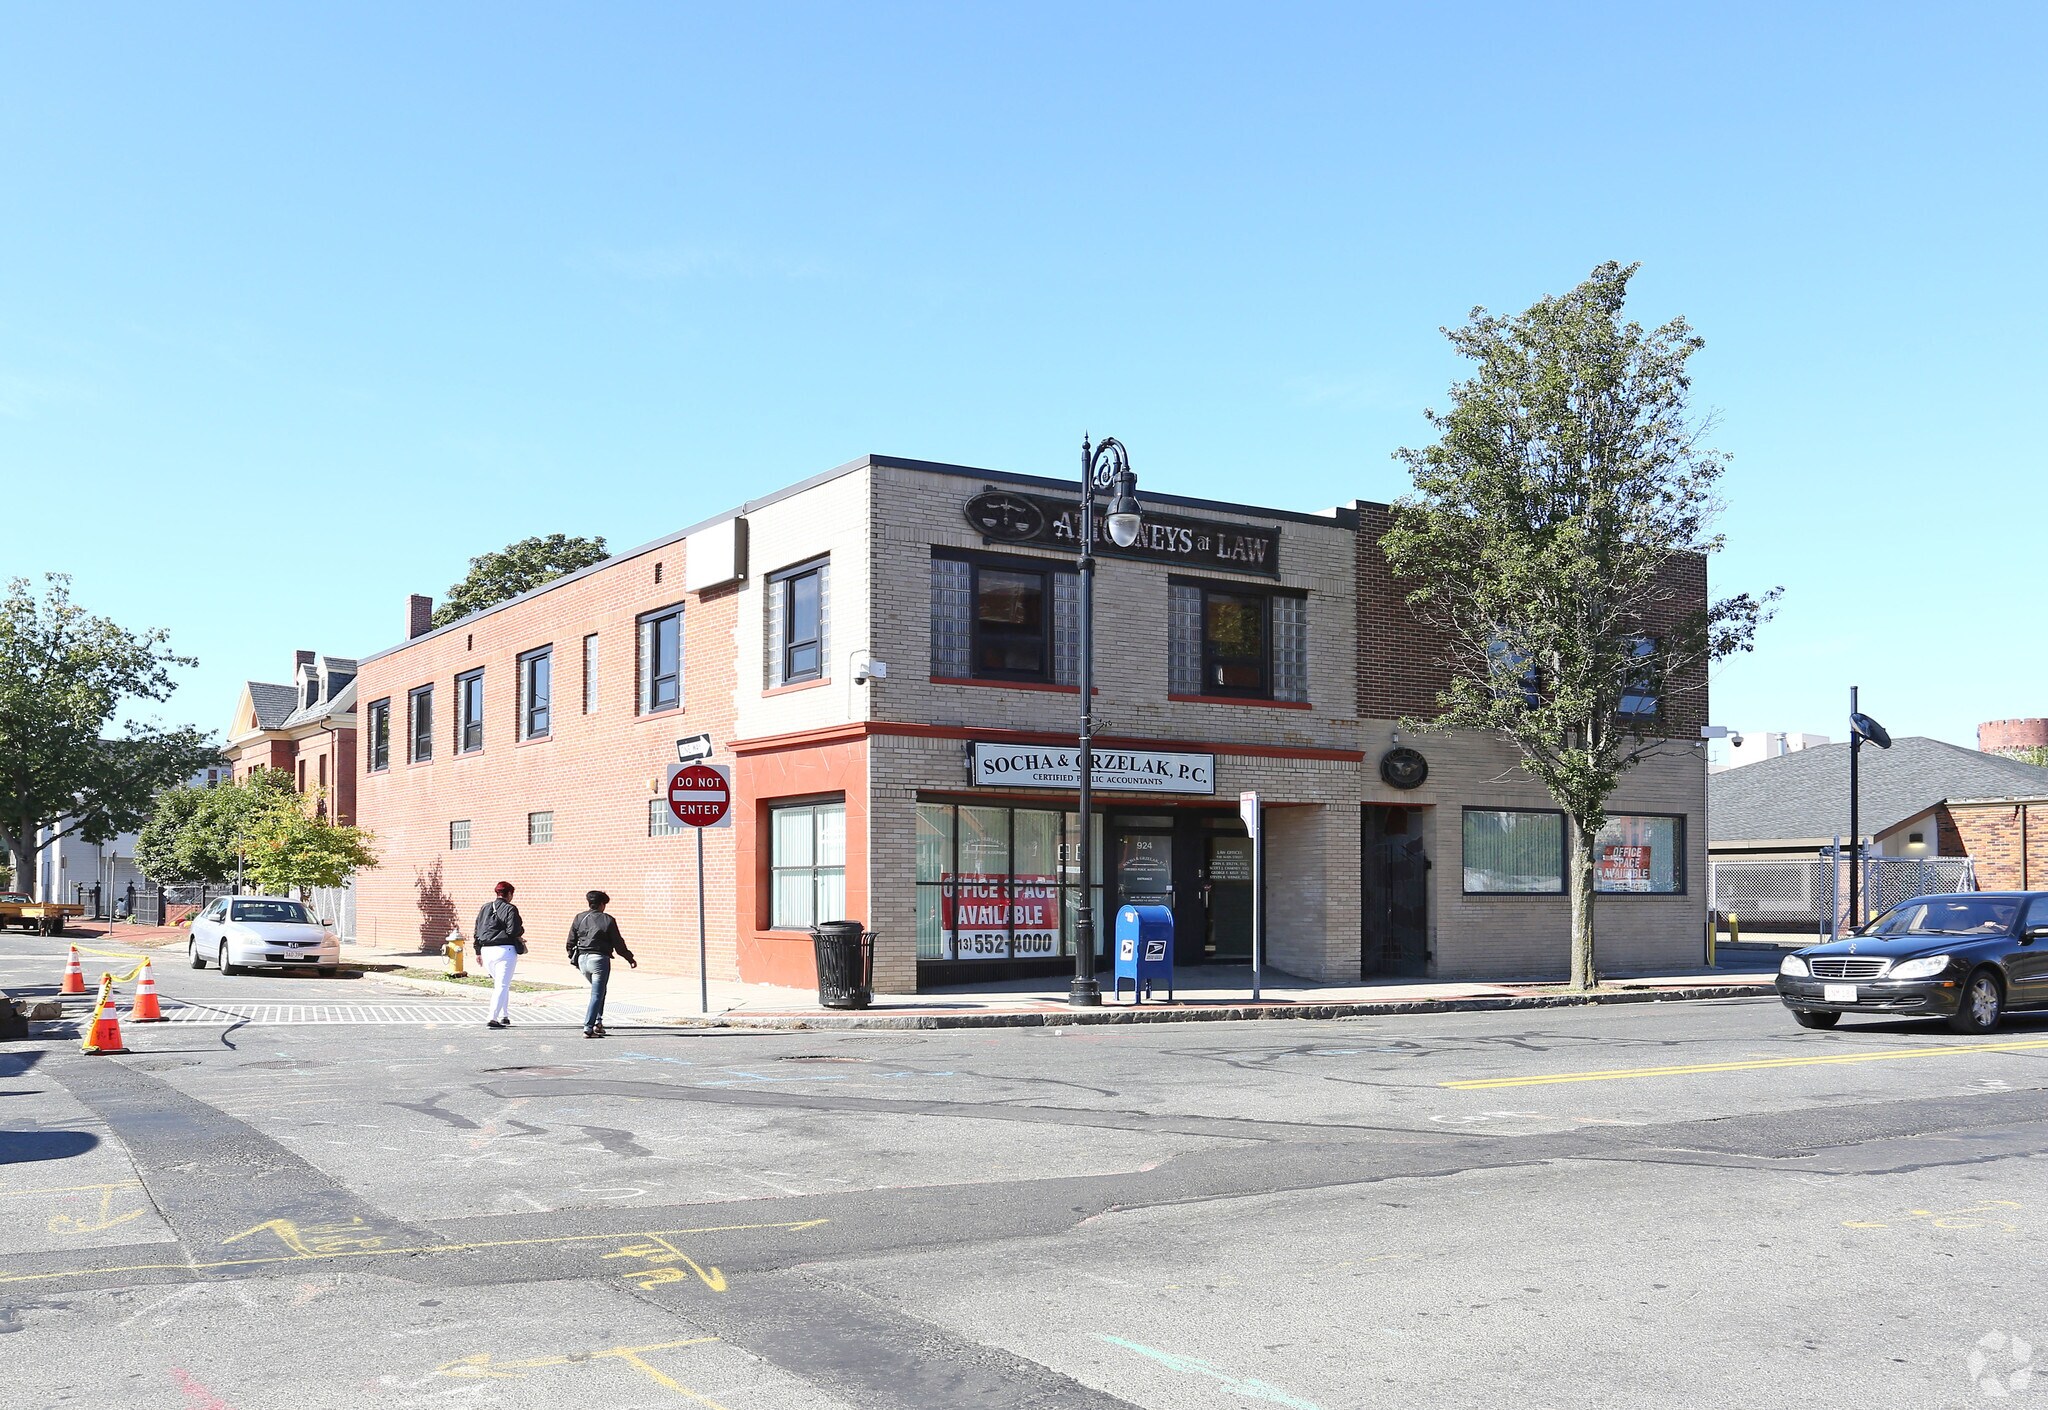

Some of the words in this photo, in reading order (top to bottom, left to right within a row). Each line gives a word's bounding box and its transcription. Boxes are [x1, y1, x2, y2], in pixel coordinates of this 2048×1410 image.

[1197, 535, 1210, 550] at
[1216, 533, 1269, 562] LAW
[984, 754, 1054, 775] SOCHA
[1057, 754, 1069, 766] &
[1179, 763, 1207, 783] P.C.
[677, 777, 693, 787] DO
[698, 777, 721, 788] NOT
[1033, 773, 1074, 782] CERTIFIED
[1107, 776, 1163, 786] ACCOUNTANTS
[680, 805, 720, 815] ENTER
[1136, 841, 1152, 850] 924
[1613, 847, 1642, 857] OFFICE
[1613, 857, 1640, 868] SPACE
[957, 905, 1043, 925] AVAILABLE
[948, 936, 972, 951] (13)
[974, 933, 1052, 954] 552-4000
